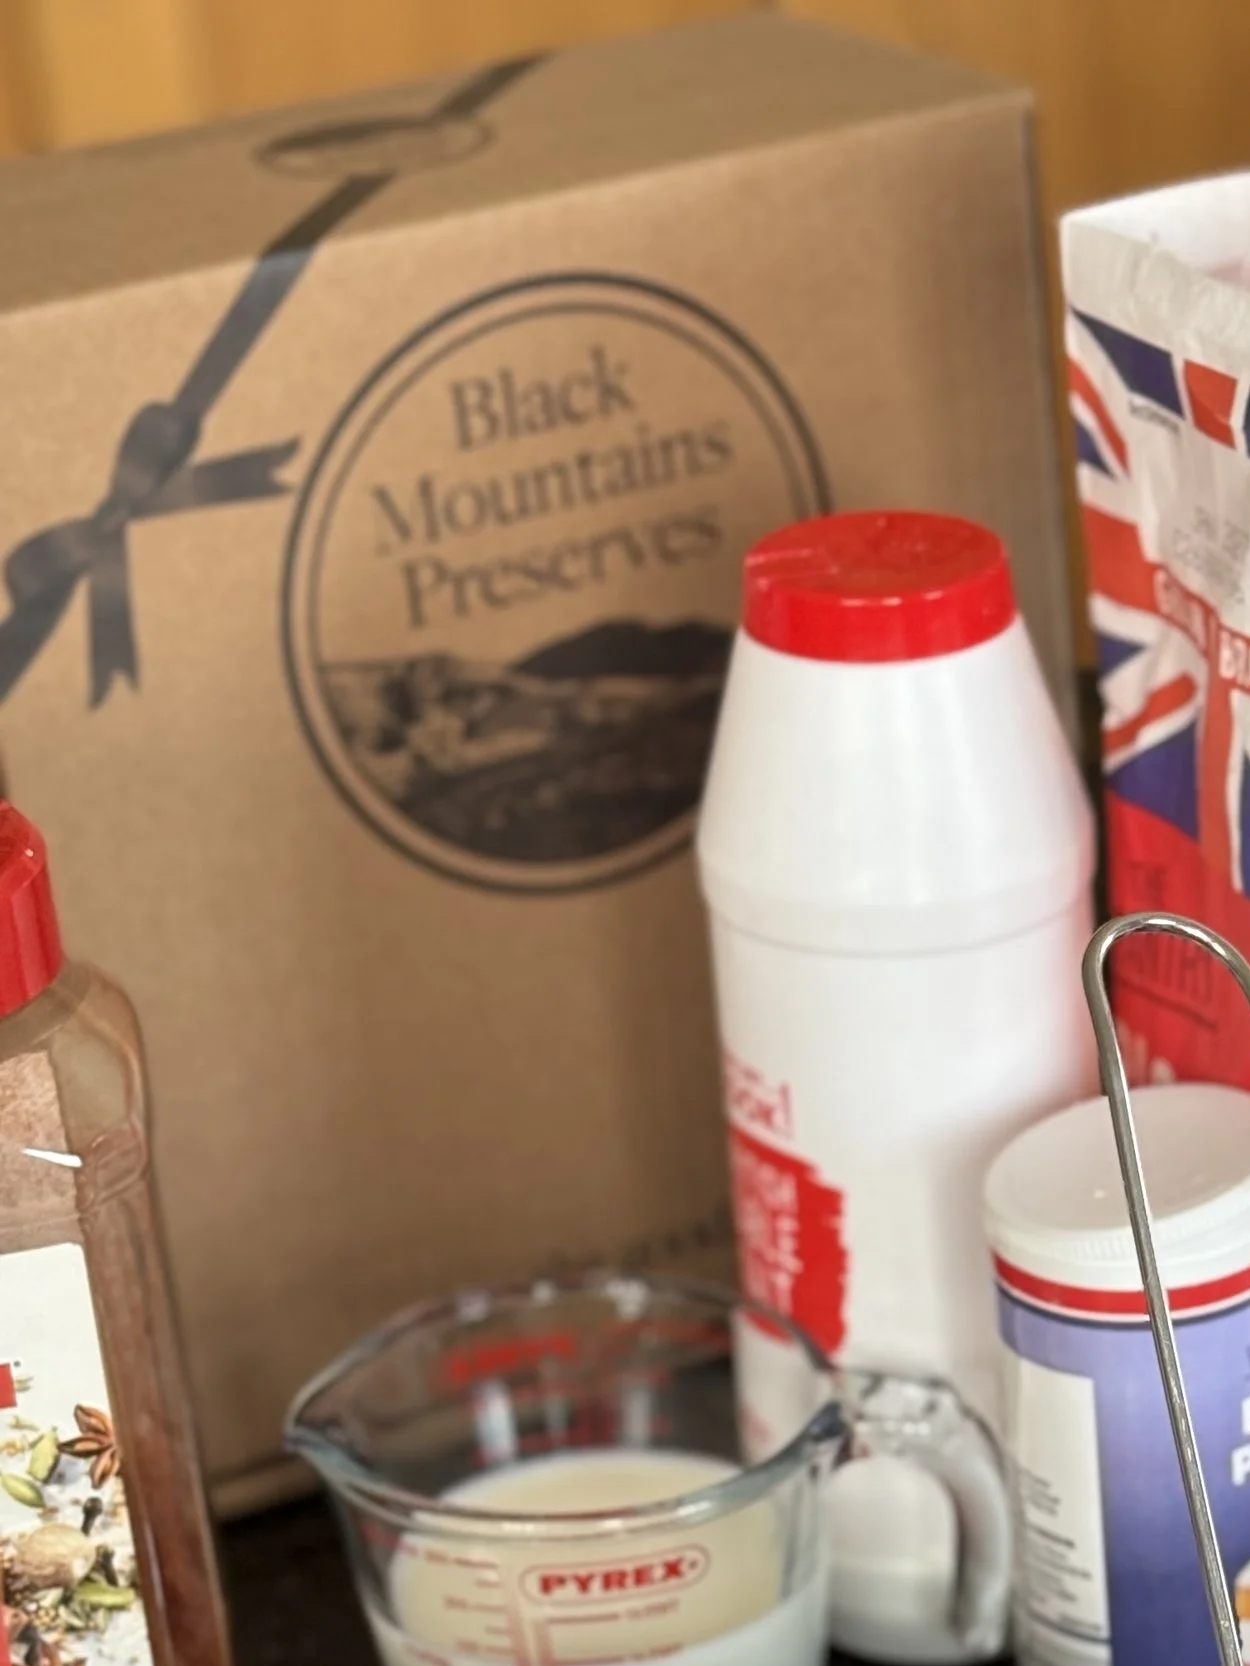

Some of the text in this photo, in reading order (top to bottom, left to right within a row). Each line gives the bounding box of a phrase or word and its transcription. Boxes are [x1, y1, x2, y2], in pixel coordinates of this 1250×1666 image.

[447, 344, 637, 453] Black
[371, 420, 735, 558] Mountains
[396, 508, 722, 631] Preserves
[539, 1556, 687, 1596] PYREX
